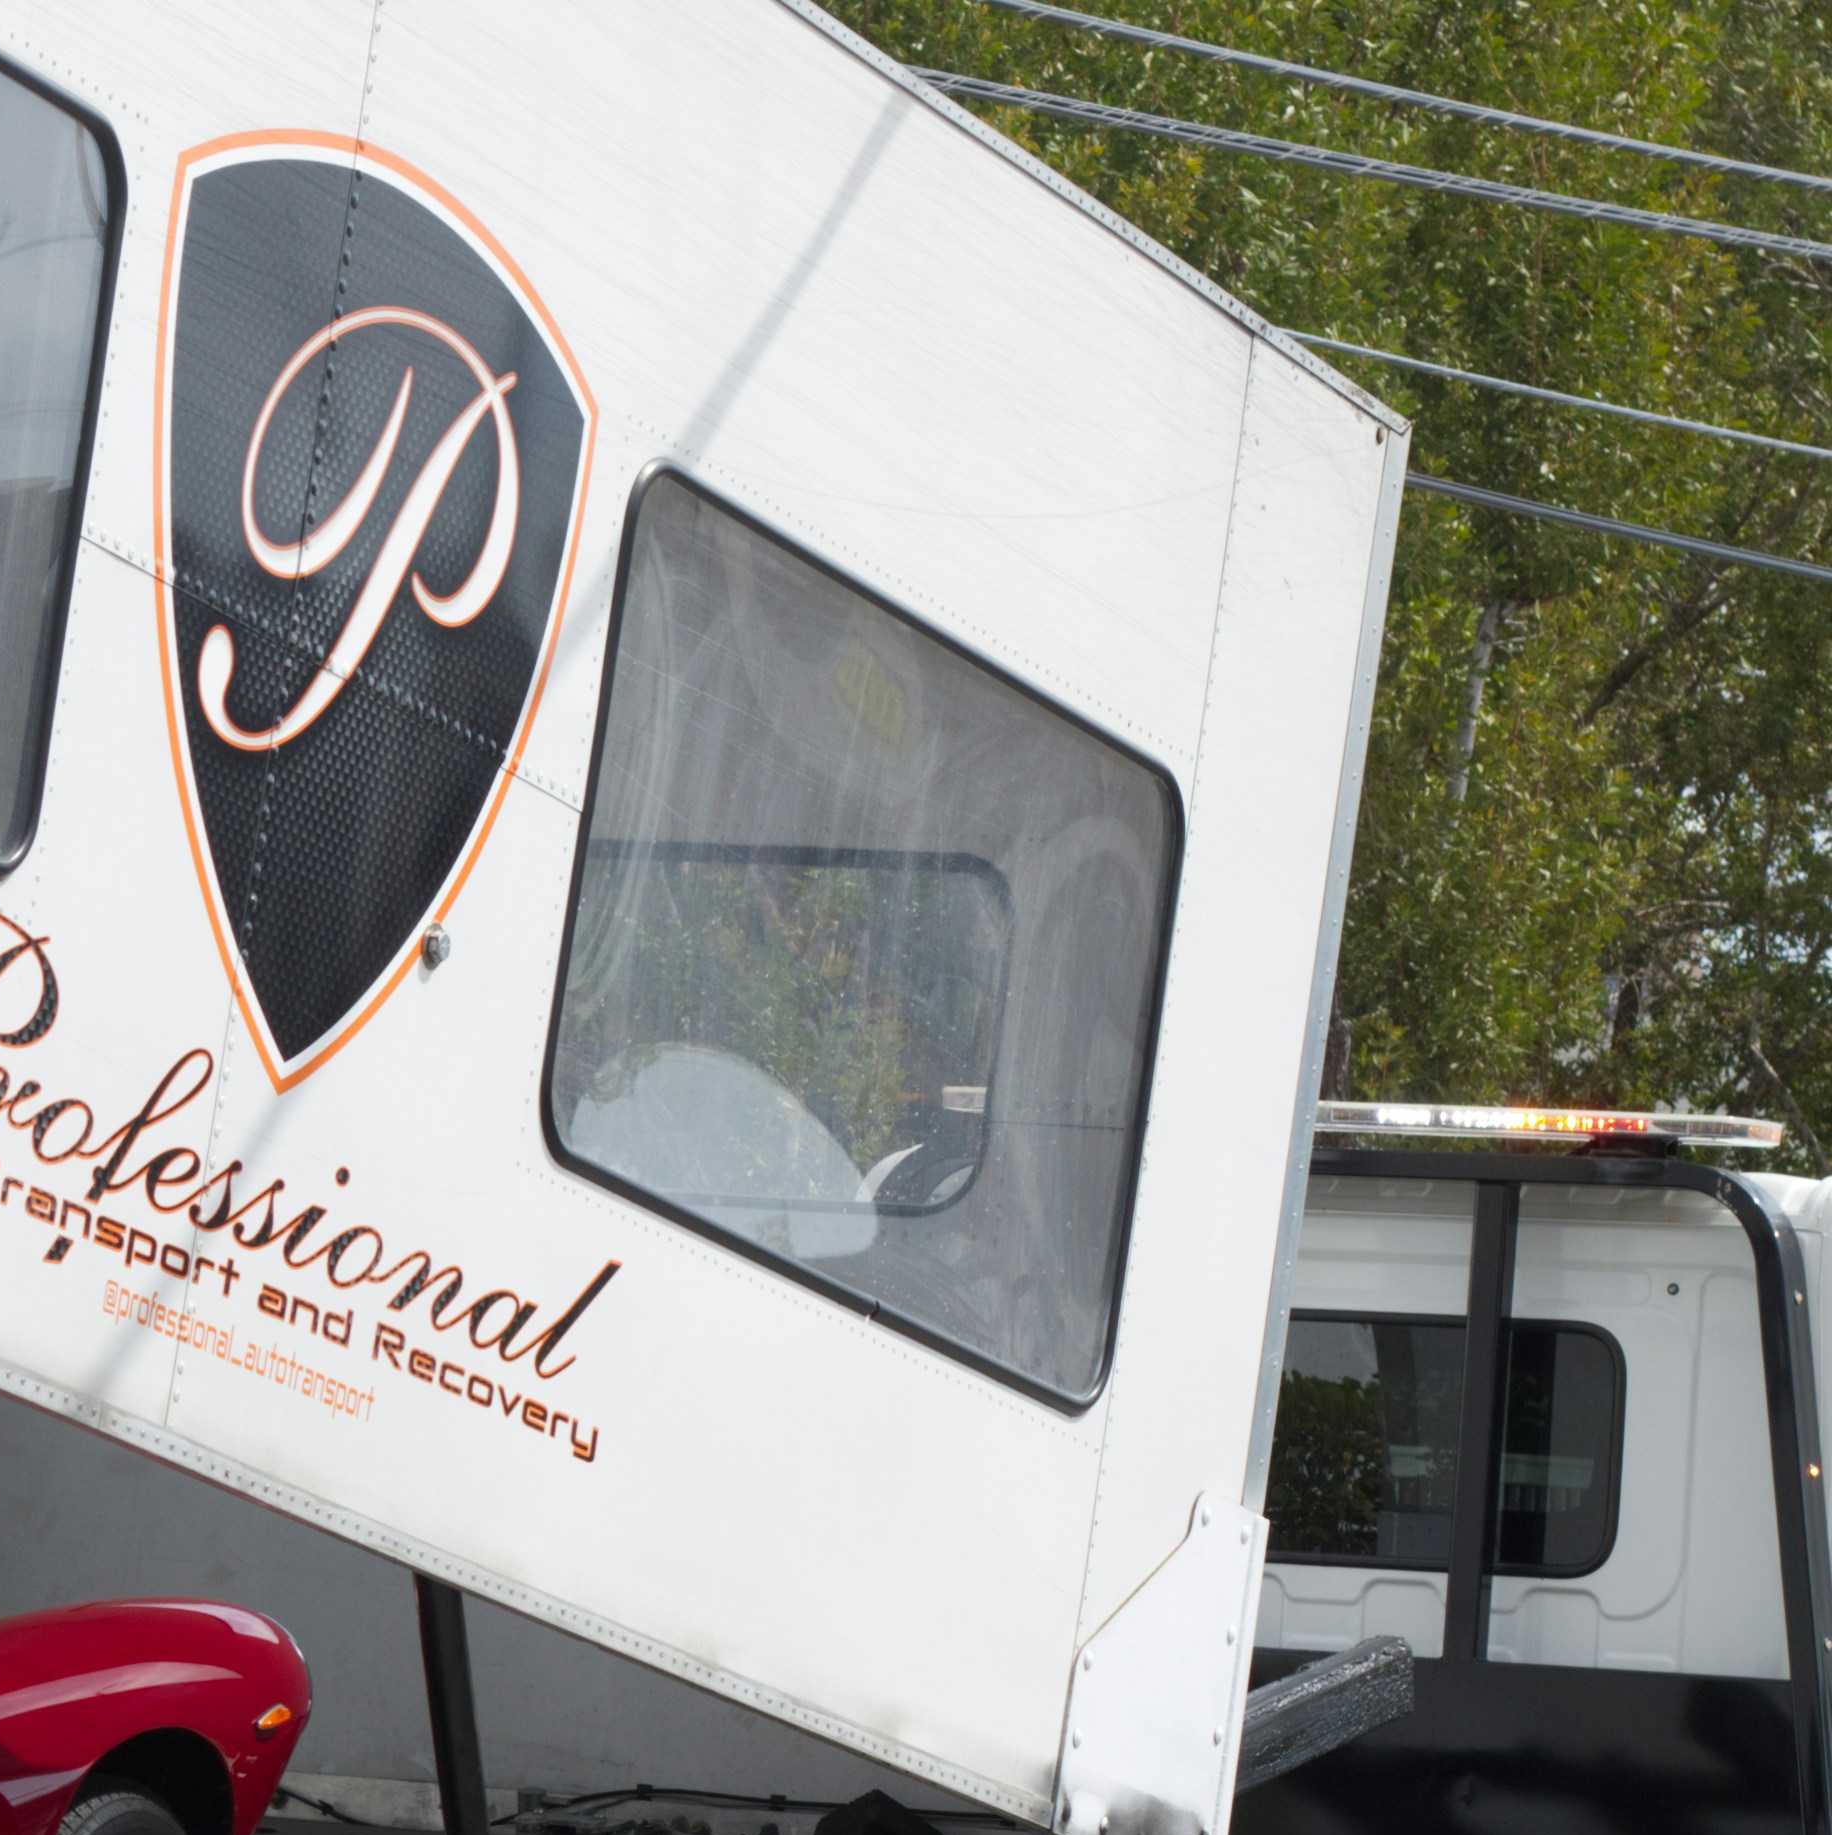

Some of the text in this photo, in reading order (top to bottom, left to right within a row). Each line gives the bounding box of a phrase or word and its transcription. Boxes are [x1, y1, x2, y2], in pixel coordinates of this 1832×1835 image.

[102, 1279, 375, 1422] @professional_autotransport
[258, 1282, 352, 1348] and
[373, 1323, 599, 1463] Recovery
